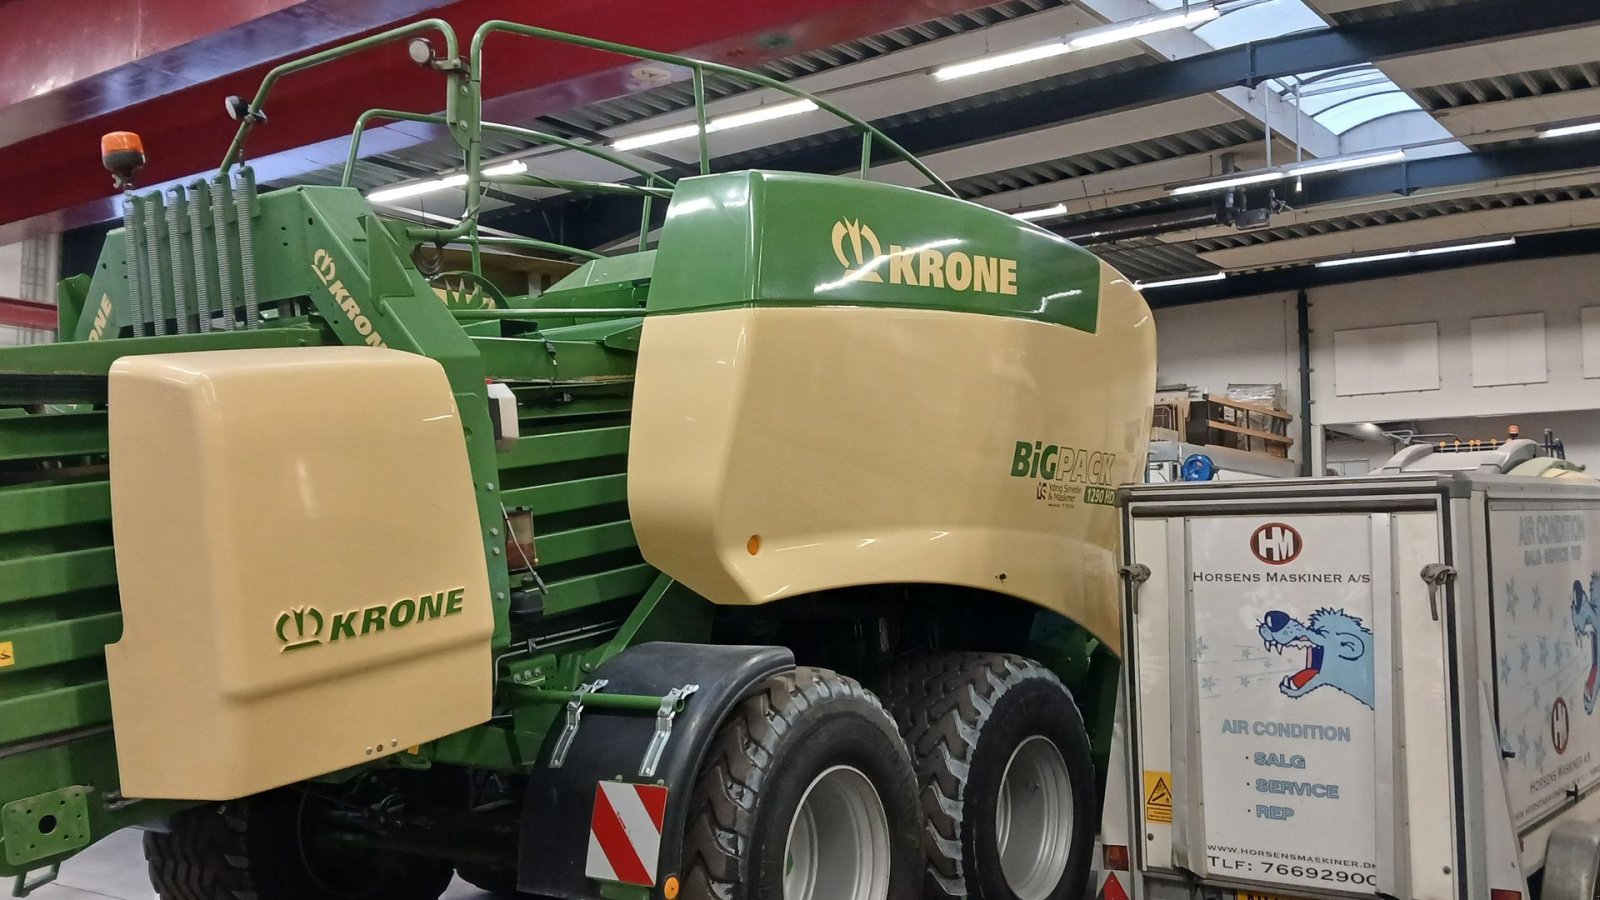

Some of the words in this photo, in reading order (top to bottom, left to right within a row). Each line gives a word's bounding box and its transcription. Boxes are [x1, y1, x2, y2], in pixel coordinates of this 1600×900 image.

[889, 244, 1018, 296] KRONE
[328, 279, 388, 348] KRON
[1258, 526, 1294, 561] HM
[1348, 573, 1371, 583] A/S
[328, 586, 465, 642] KRONE
[1221, 719, 1249, 735] AIR
[1252, 721, 1351, 742] CONDITION
[1253, 752, 1306, 769] SALG
[1255, 778, 1340, 799] SERVICE
[1255, 804, 1295, 820] REP
